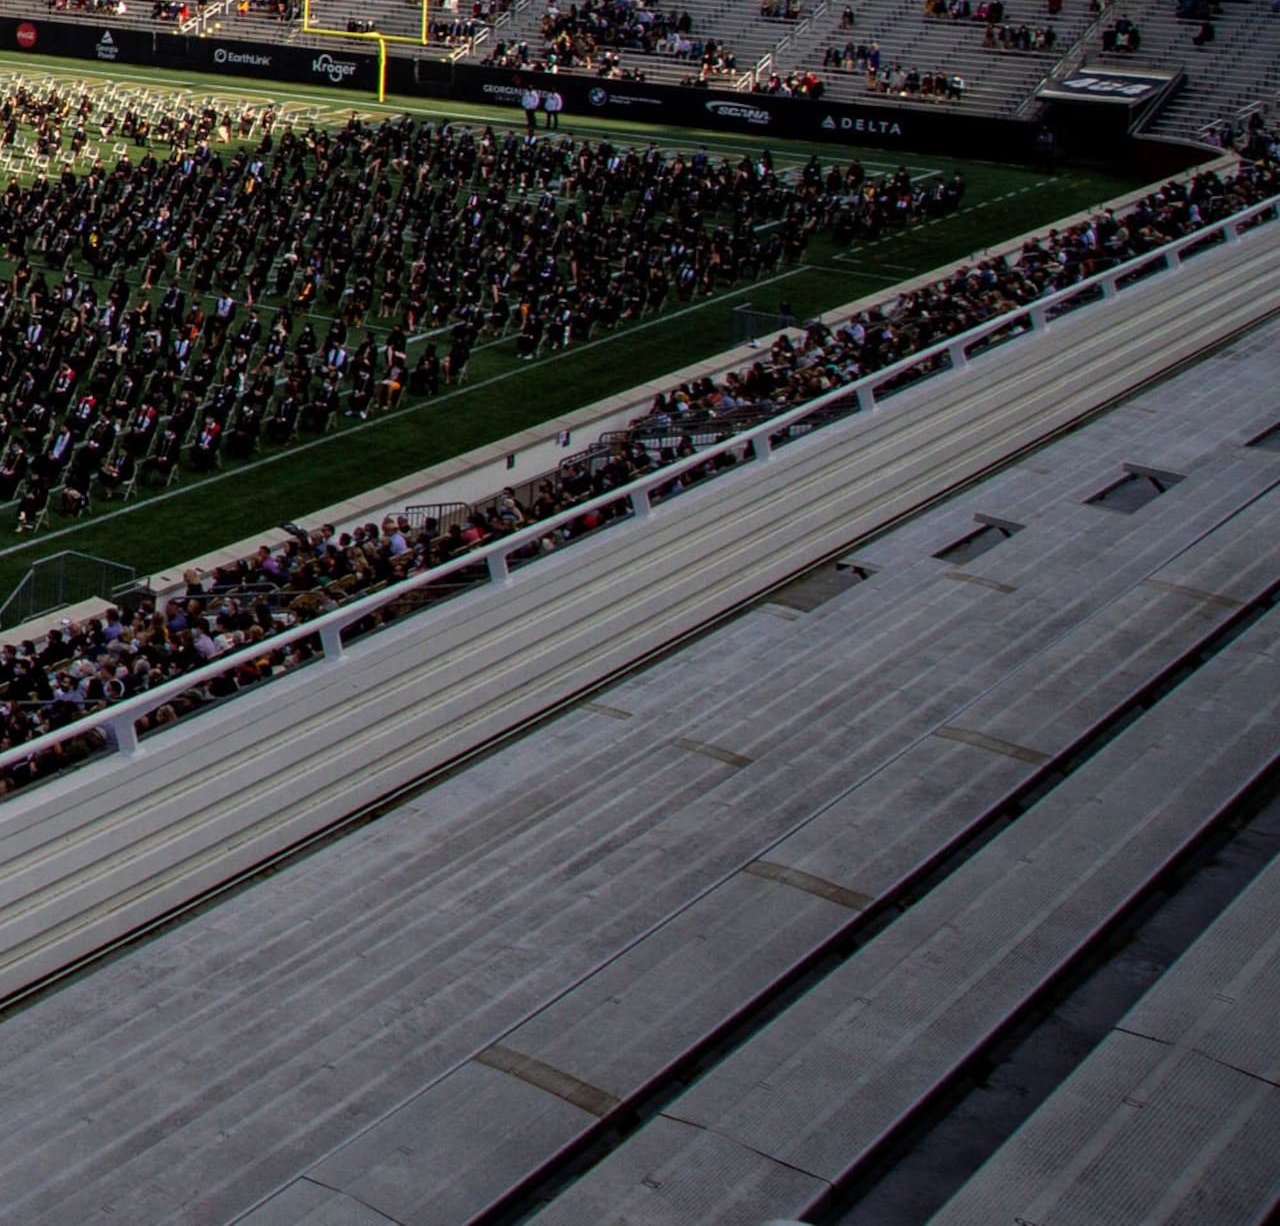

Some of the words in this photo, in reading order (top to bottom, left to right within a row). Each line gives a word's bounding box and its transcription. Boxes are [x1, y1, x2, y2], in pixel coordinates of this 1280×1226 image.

[228, 52, 272, 66] EarthLink
[312, 54, 356, 82] Kroger
[717, 106, 772, 120] SCANA
[840, 117, 902, 135] DELTA
